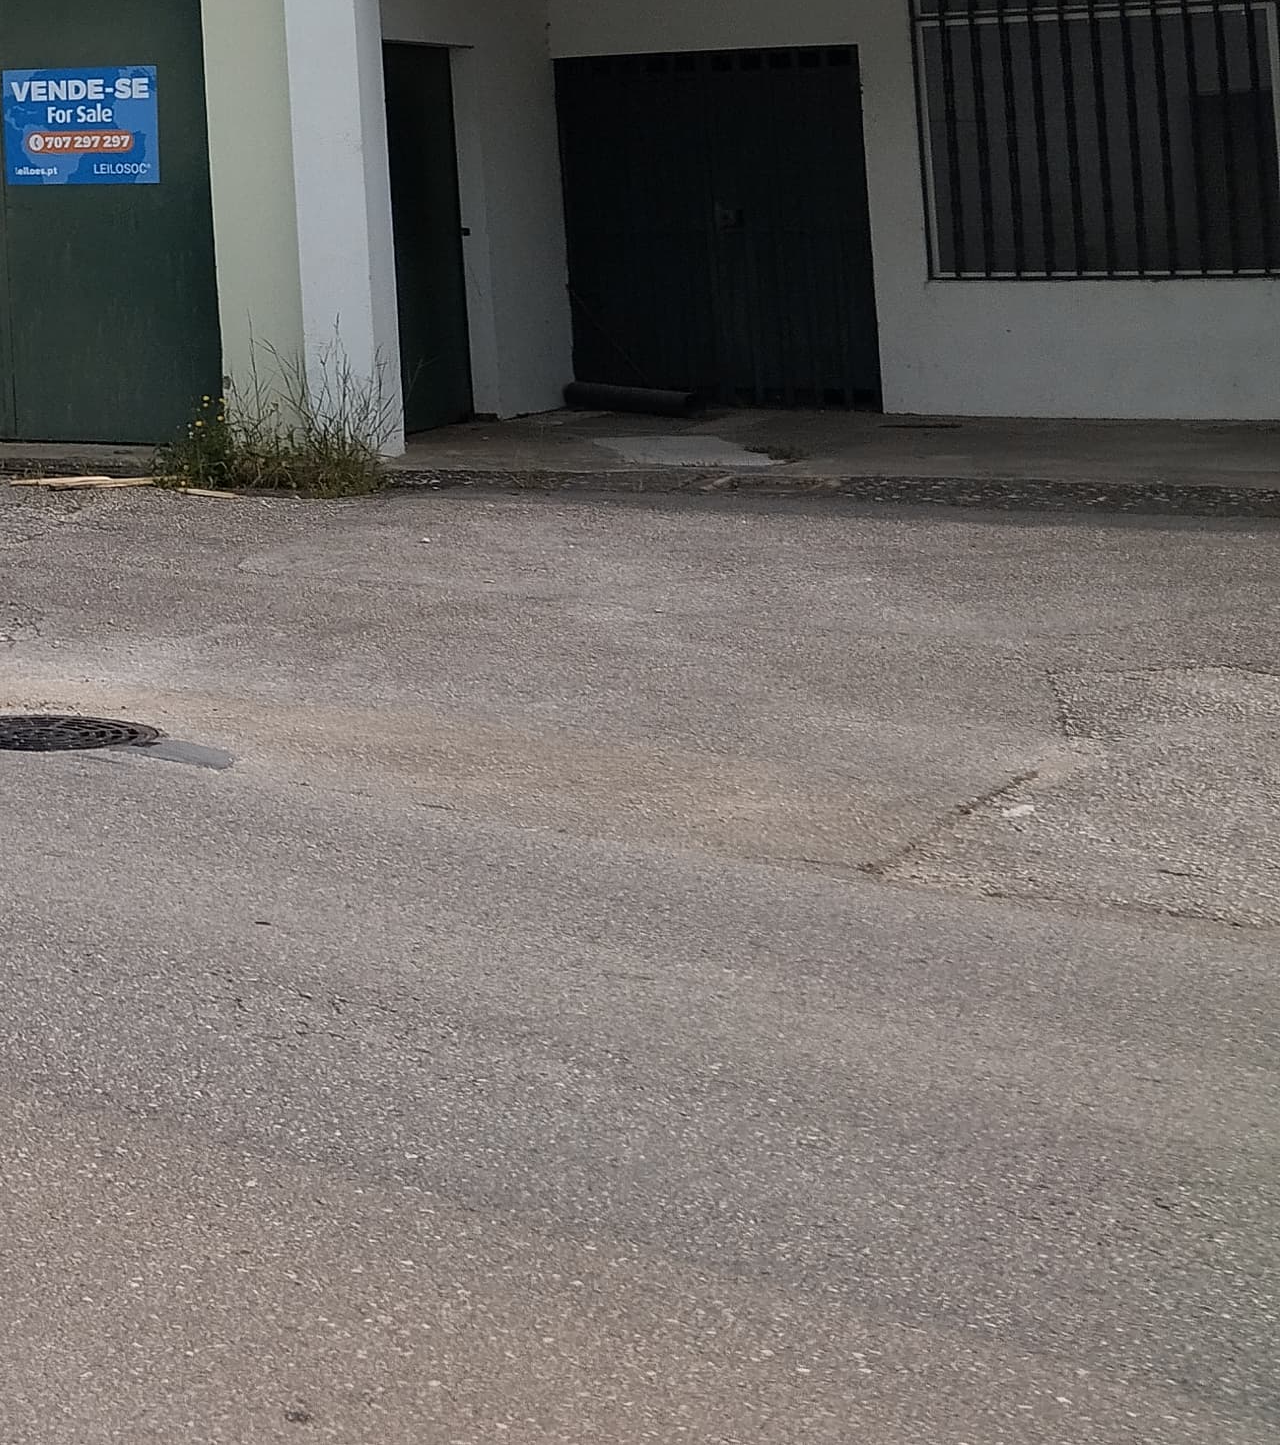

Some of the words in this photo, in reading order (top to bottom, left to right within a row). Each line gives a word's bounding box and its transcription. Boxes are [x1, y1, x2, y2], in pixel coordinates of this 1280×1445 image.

[11, 77, 150, 102] VENDE-SE
[47, 106, 72, 124] For
[76, 103, 113, 123] Sale
[45, 137, 72, 149] 707
[73, 136, 100, 148] 297
[102, 135, 130, 148] 297
[93, 163, 148, 175] LEILOSOC
